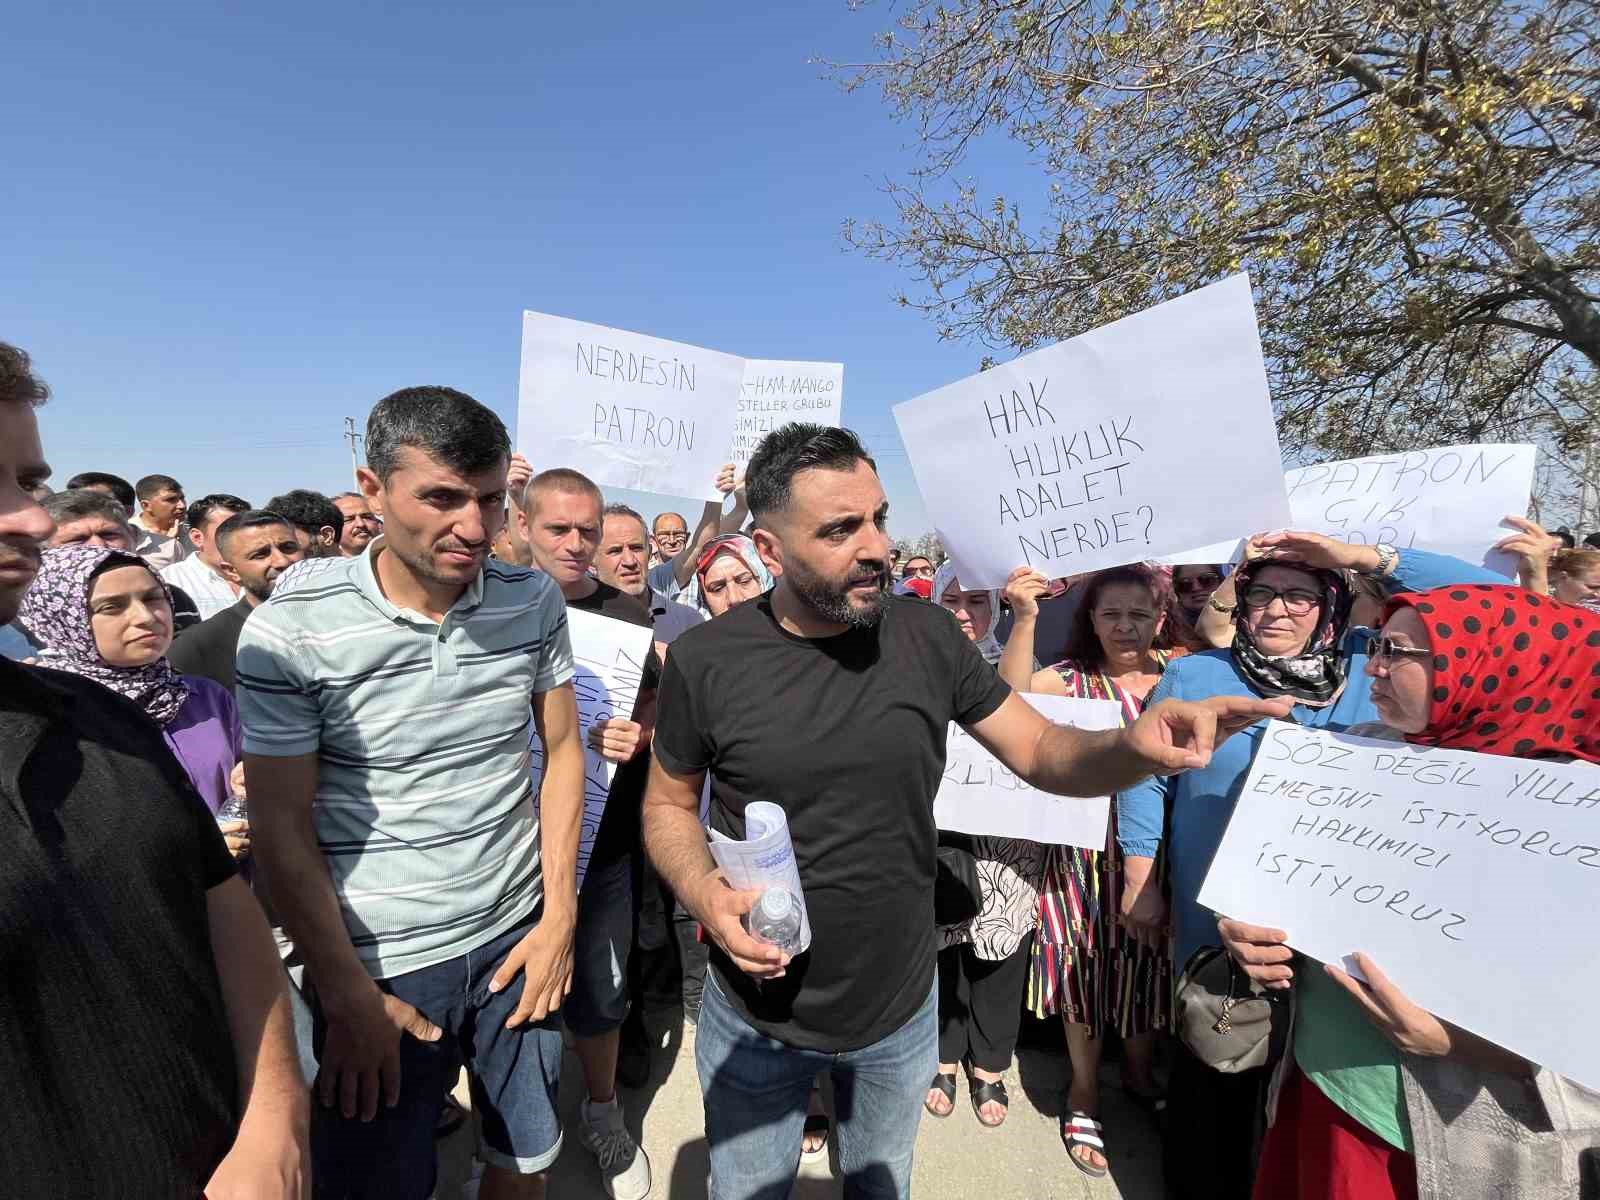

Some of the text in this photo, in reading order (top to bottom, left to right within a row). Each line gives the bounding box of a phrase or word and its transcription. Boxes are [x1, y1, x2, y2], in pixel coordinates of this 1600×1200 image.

[576, 342, 695, 391] NERDESİN
[593, 402, 695, 451] PATRON
[983, 377, 1056, 438] HAK
[1009, 415, 1144, 480] HUKUK
[1288, 450, 1516, 496] PATRON
[999, 462, 1130, 525] ADALET
[1018, 505, 1154, 566] NERDE?
[1266, 728, 1354, 771] SÖZ
[1291, 814, 1451, 869] HAKKIMIZI
[1255, 842, 1467, 940] İSTİYORUZ
